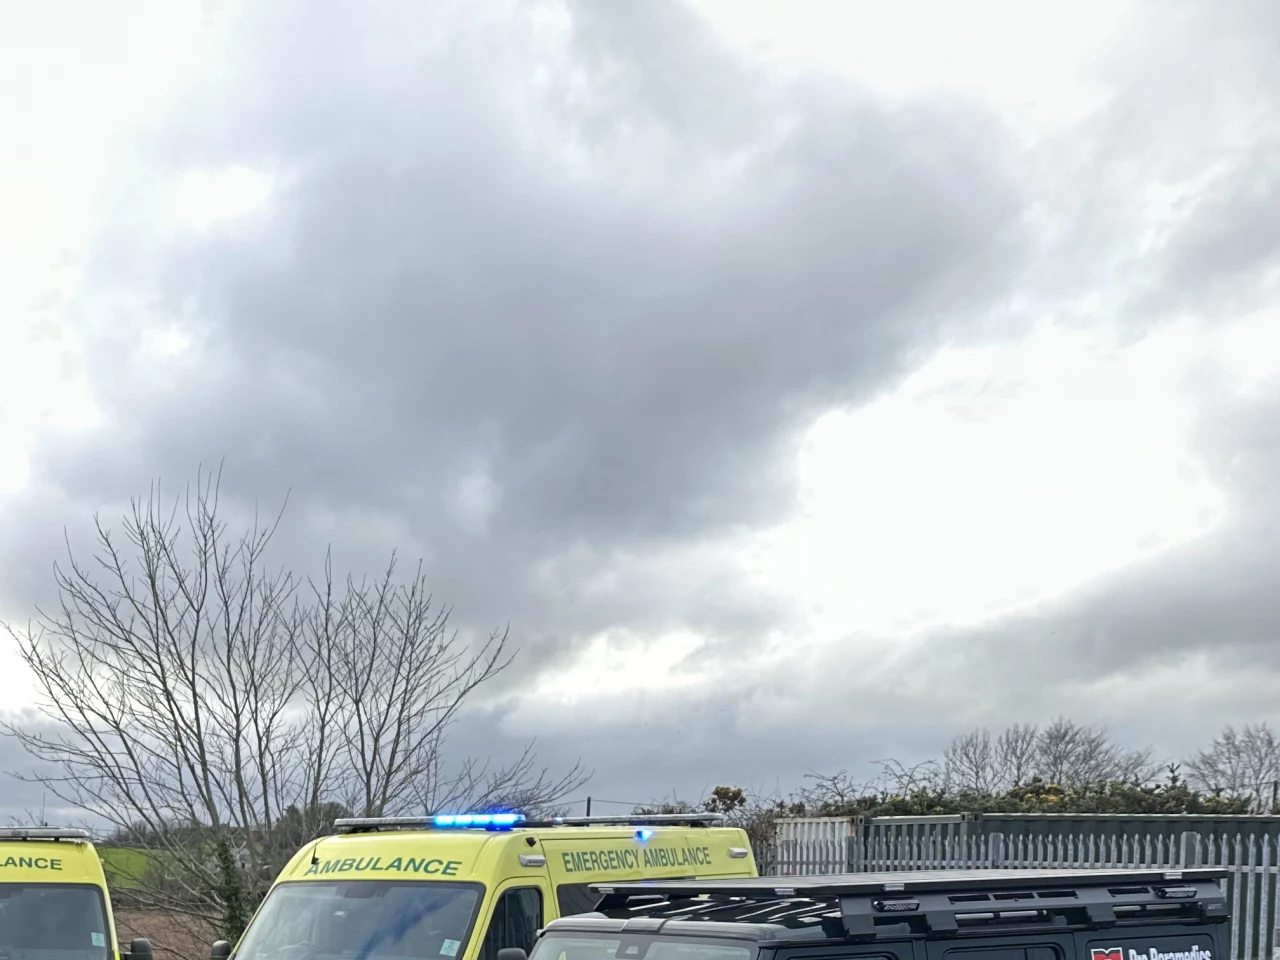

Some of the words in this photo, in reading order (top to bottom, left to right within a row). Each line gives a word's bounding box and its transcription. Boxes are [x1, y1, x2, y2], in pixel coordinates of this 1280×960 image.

[303, 857, 462, 877] AMBULANCE
[561, 848, 640, 873] EMERGENCY
[643, 846, 712, 868] AMBULANCE
